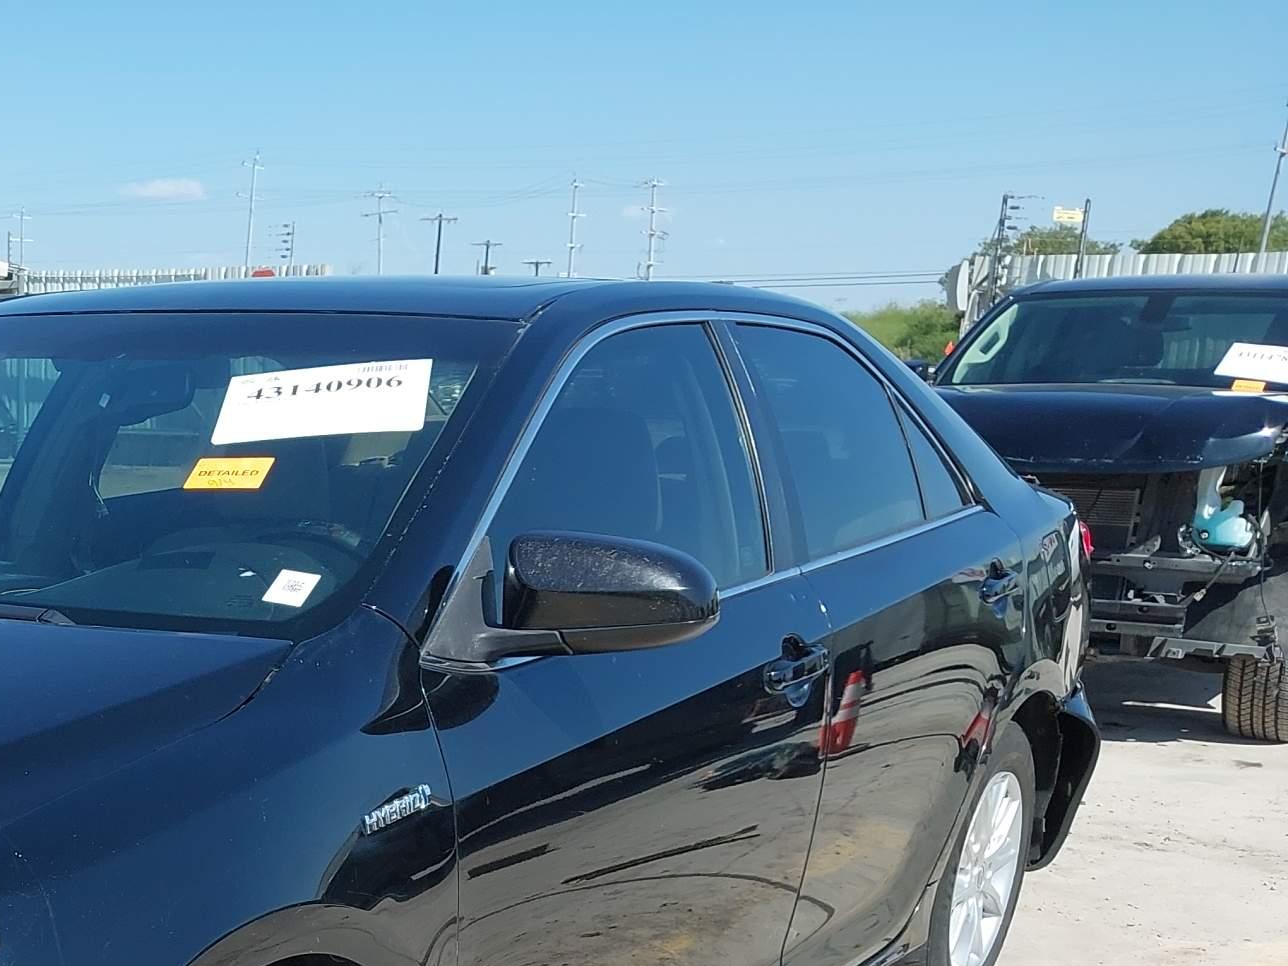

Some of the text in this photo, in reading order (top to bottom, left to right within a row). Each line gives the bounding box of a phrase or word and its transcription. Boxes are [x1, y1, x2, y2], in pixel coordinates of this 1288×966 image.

[247, 375, 403, 400] 43140906
[198, 469, 260, 477] DETAILED
[364, 784, 430, 834] HYBRID
